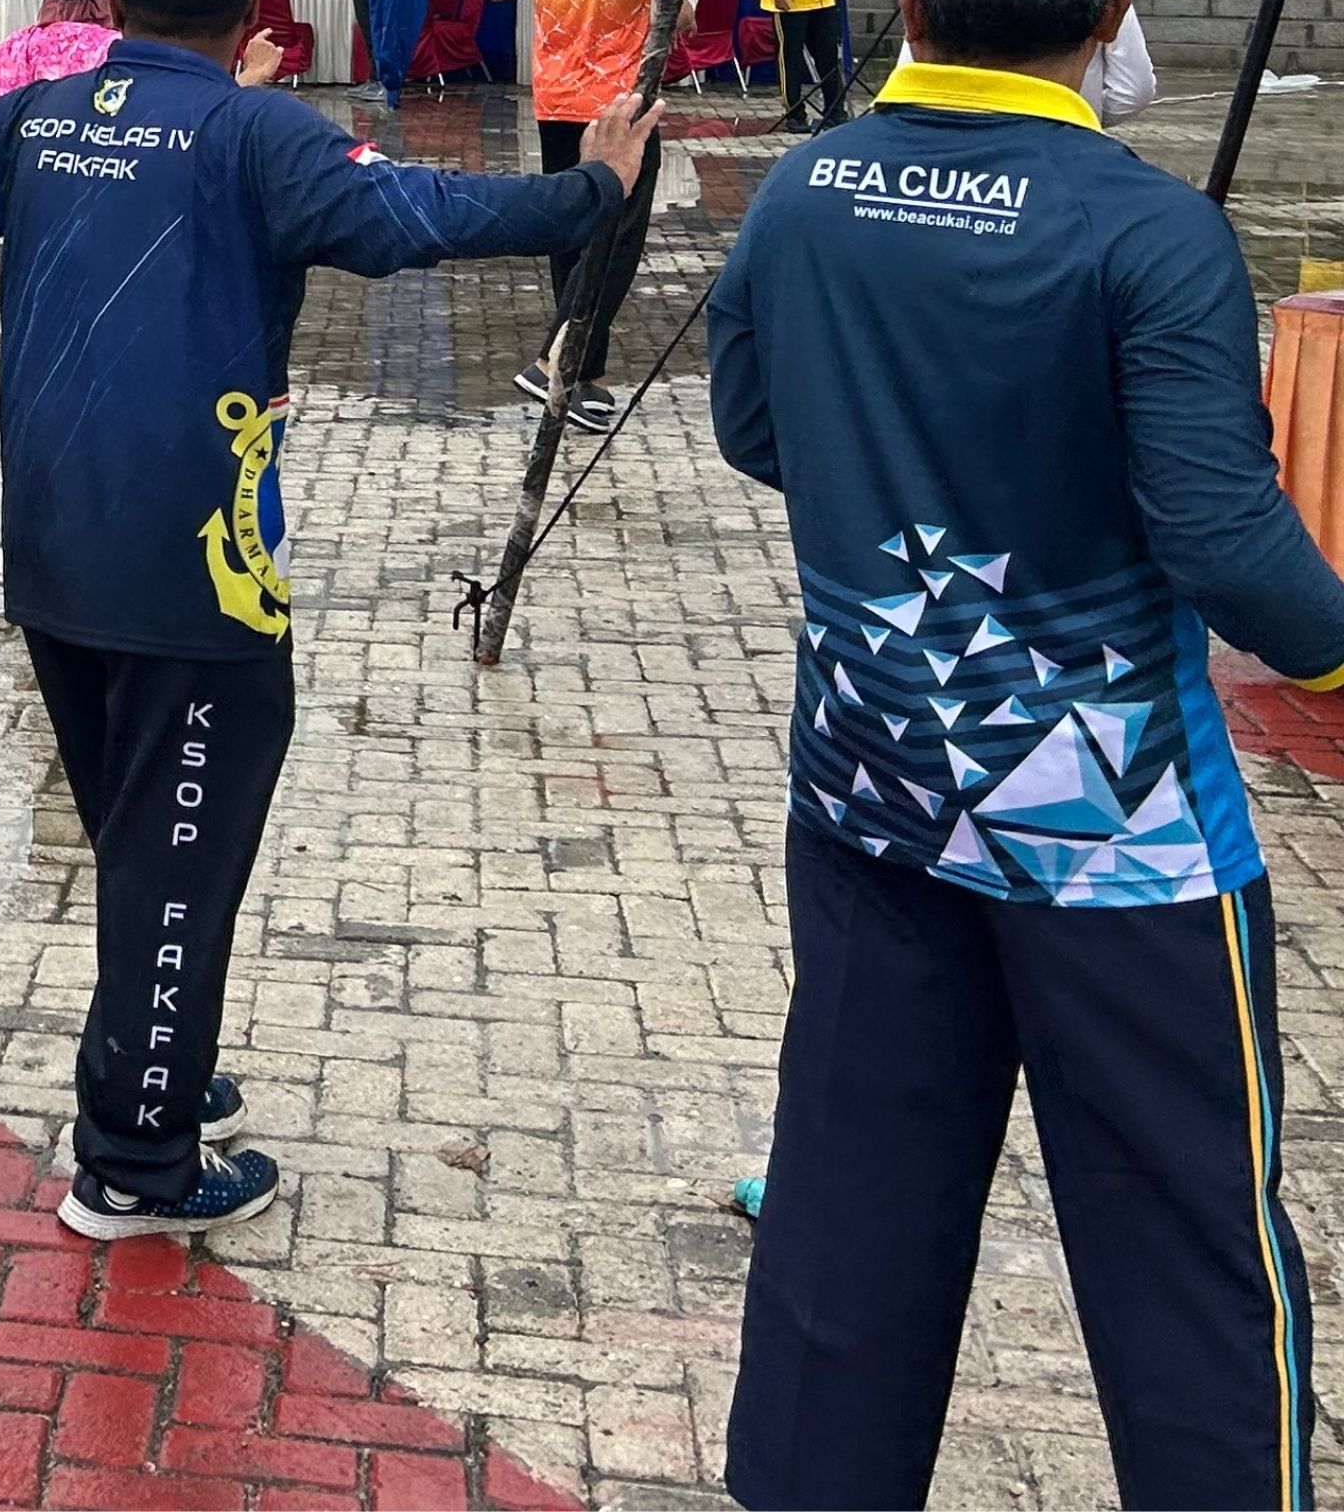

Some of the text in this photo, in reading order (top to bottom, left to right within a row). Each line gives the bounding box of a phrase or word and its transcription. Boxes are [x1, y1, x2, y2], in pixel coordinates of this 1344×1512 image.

[80, 123, 161, 148] KELAS
[167, 129, 194, 151] IV
[37, 149, 139, 180] FAKFAK
[808, 158, 1030, 209] BEA CUKAI
[853, 205, 1017, 235] www.beacukai.go.id
[172, 702, 213, 846] KSOP
[136, 903, 188, 1128] FAKFAK
